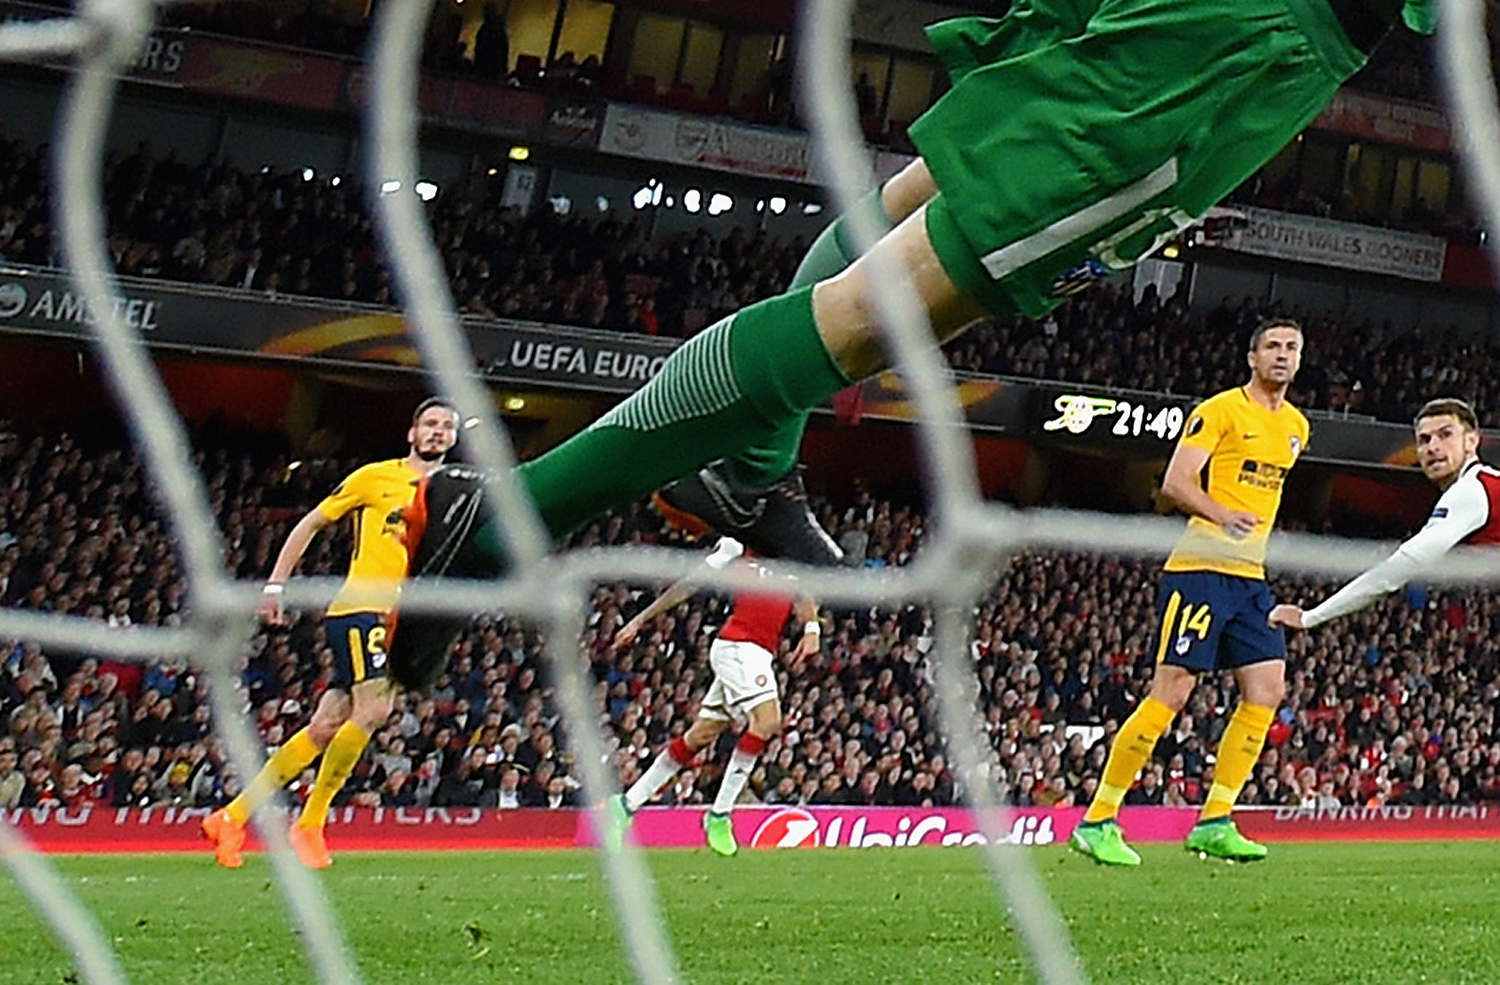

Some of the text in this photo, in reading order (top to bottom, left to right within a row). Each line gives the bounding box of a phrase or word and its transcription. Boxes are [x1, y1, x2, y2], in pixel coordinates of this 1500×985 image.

[1248, 220, 1302, 245] SOUTH
[1308, 230, 1362, 256] WALES
[30, 290, 160, 331] AMTEL
[510, 340, 669, 381] UEFA EURO
[1112, 401, 1184, 440] 21:49
[1178, 603, 1211, 640] 14
